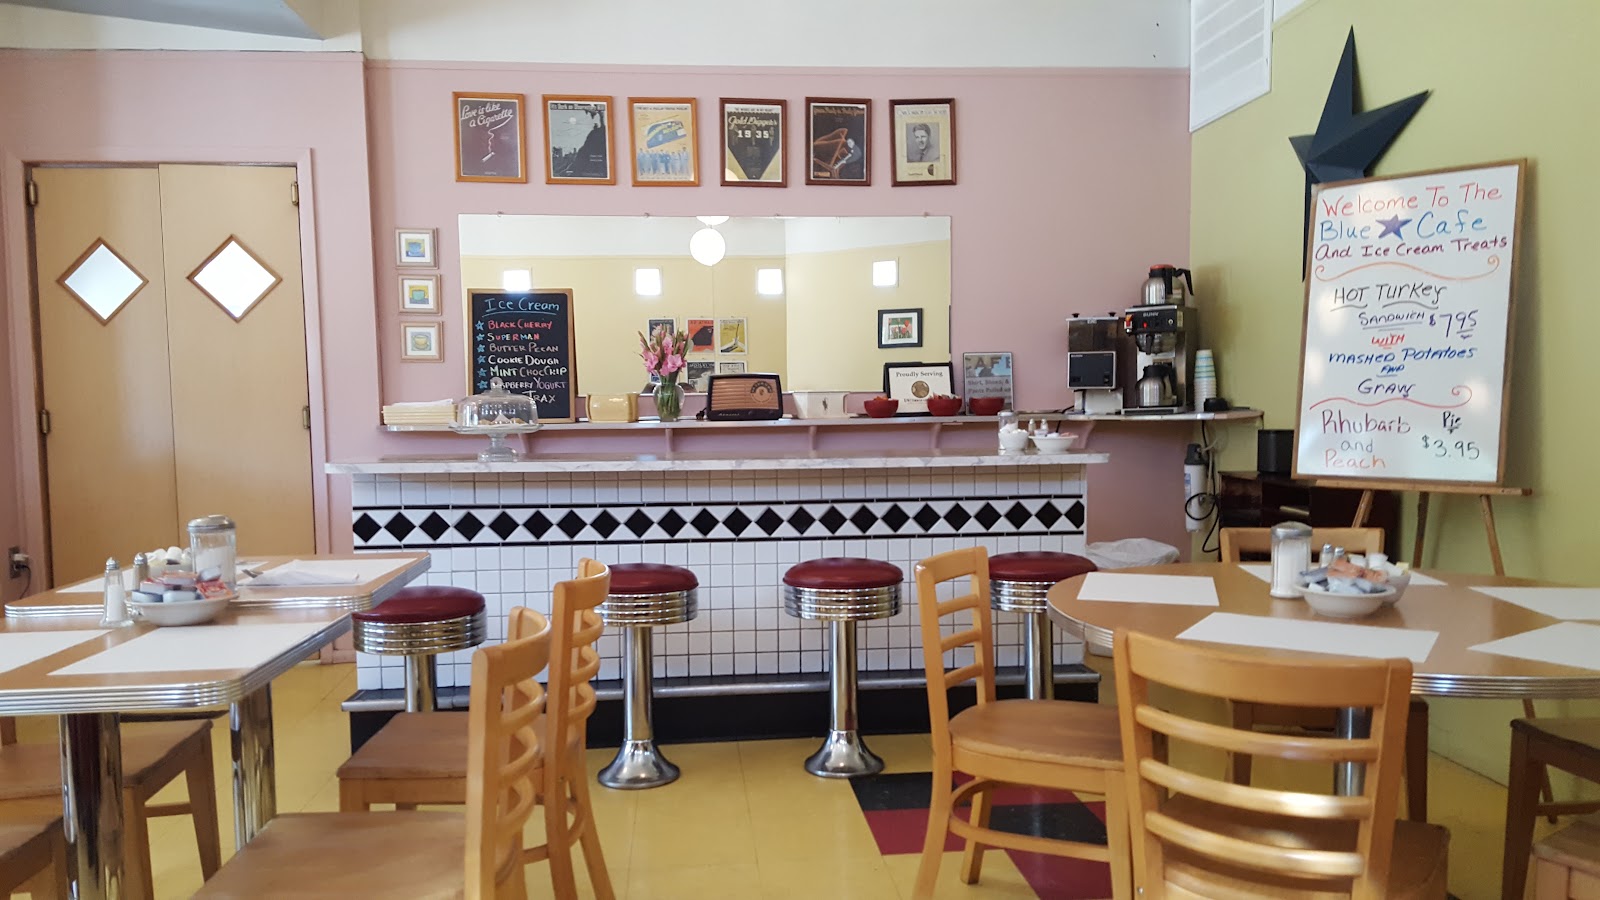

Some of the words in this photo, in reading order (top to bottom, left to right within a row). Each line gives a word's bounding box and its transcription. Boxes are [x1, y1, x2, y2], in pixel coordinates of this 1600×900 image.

[461, 105, 477, 120] Love
[478, 106, 485, 115] is
[485, 103, 501, 113] like
[469, 119, 476, 128] a
[477, 109, 513, 127] Cigarette
[1322, 194, 1419, 217] Welcome
[1425, 186, 1449, 208] To
[1459, 182, 1503, 203] The
[1320, 219, 1371, 241] Blue
[1416, 209, 1488, 239] Cafe
[1361, 245, 1390, 257] Ice
[1395, 244, 1444, 255] Cream
[1450, 235, 1508, 251] Treats
[1333, 284, 1371, 304] HOT
[485, 299, 514, 313] Ice
[519, 298, 560, 311] Cream
[488, 320, 516, 330] BLACK
[487, 333, 541, 342] SUPERMAN
[488, 355, 524, 365] COOKIE
[525, 355, 560, 367] DOUGH
[490, 365, 519, 377] MINT
[1322, 409, 1411, 435] Rhubarb
[1442, 410, 1462, 429] Pie
[1341, 439, 1374, 453] and
[1421, 434, 1481, 461] $3.95
[1324, 448, 1387, 470] Peach
